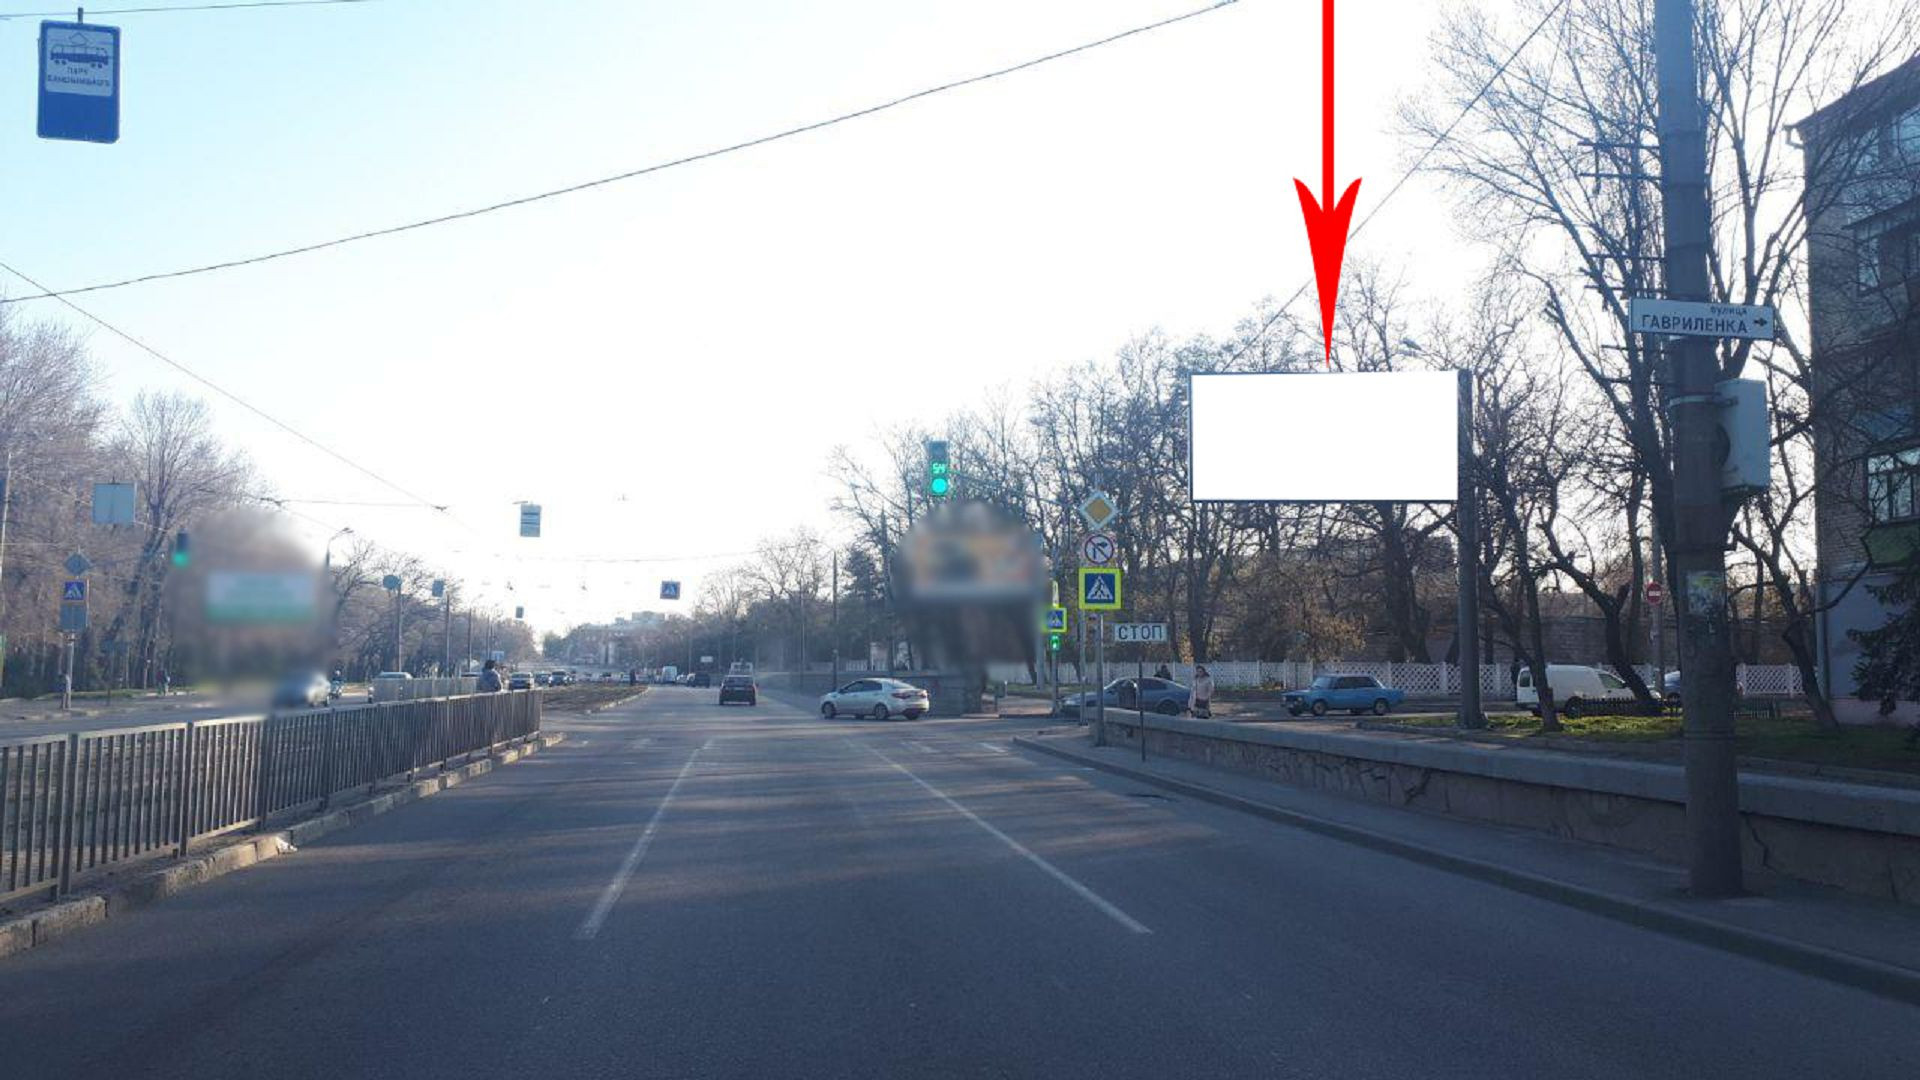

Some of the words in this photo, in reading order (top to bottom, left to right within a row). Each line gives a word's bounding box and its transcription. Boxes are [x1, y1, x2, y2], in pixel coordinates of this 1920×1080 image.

[1710, 305, 1747, 318] вулиця
[1642, 314, 1748, 334] ГАВРИЛЕНКА
[1118, 625, 1162, 640] СТОП
